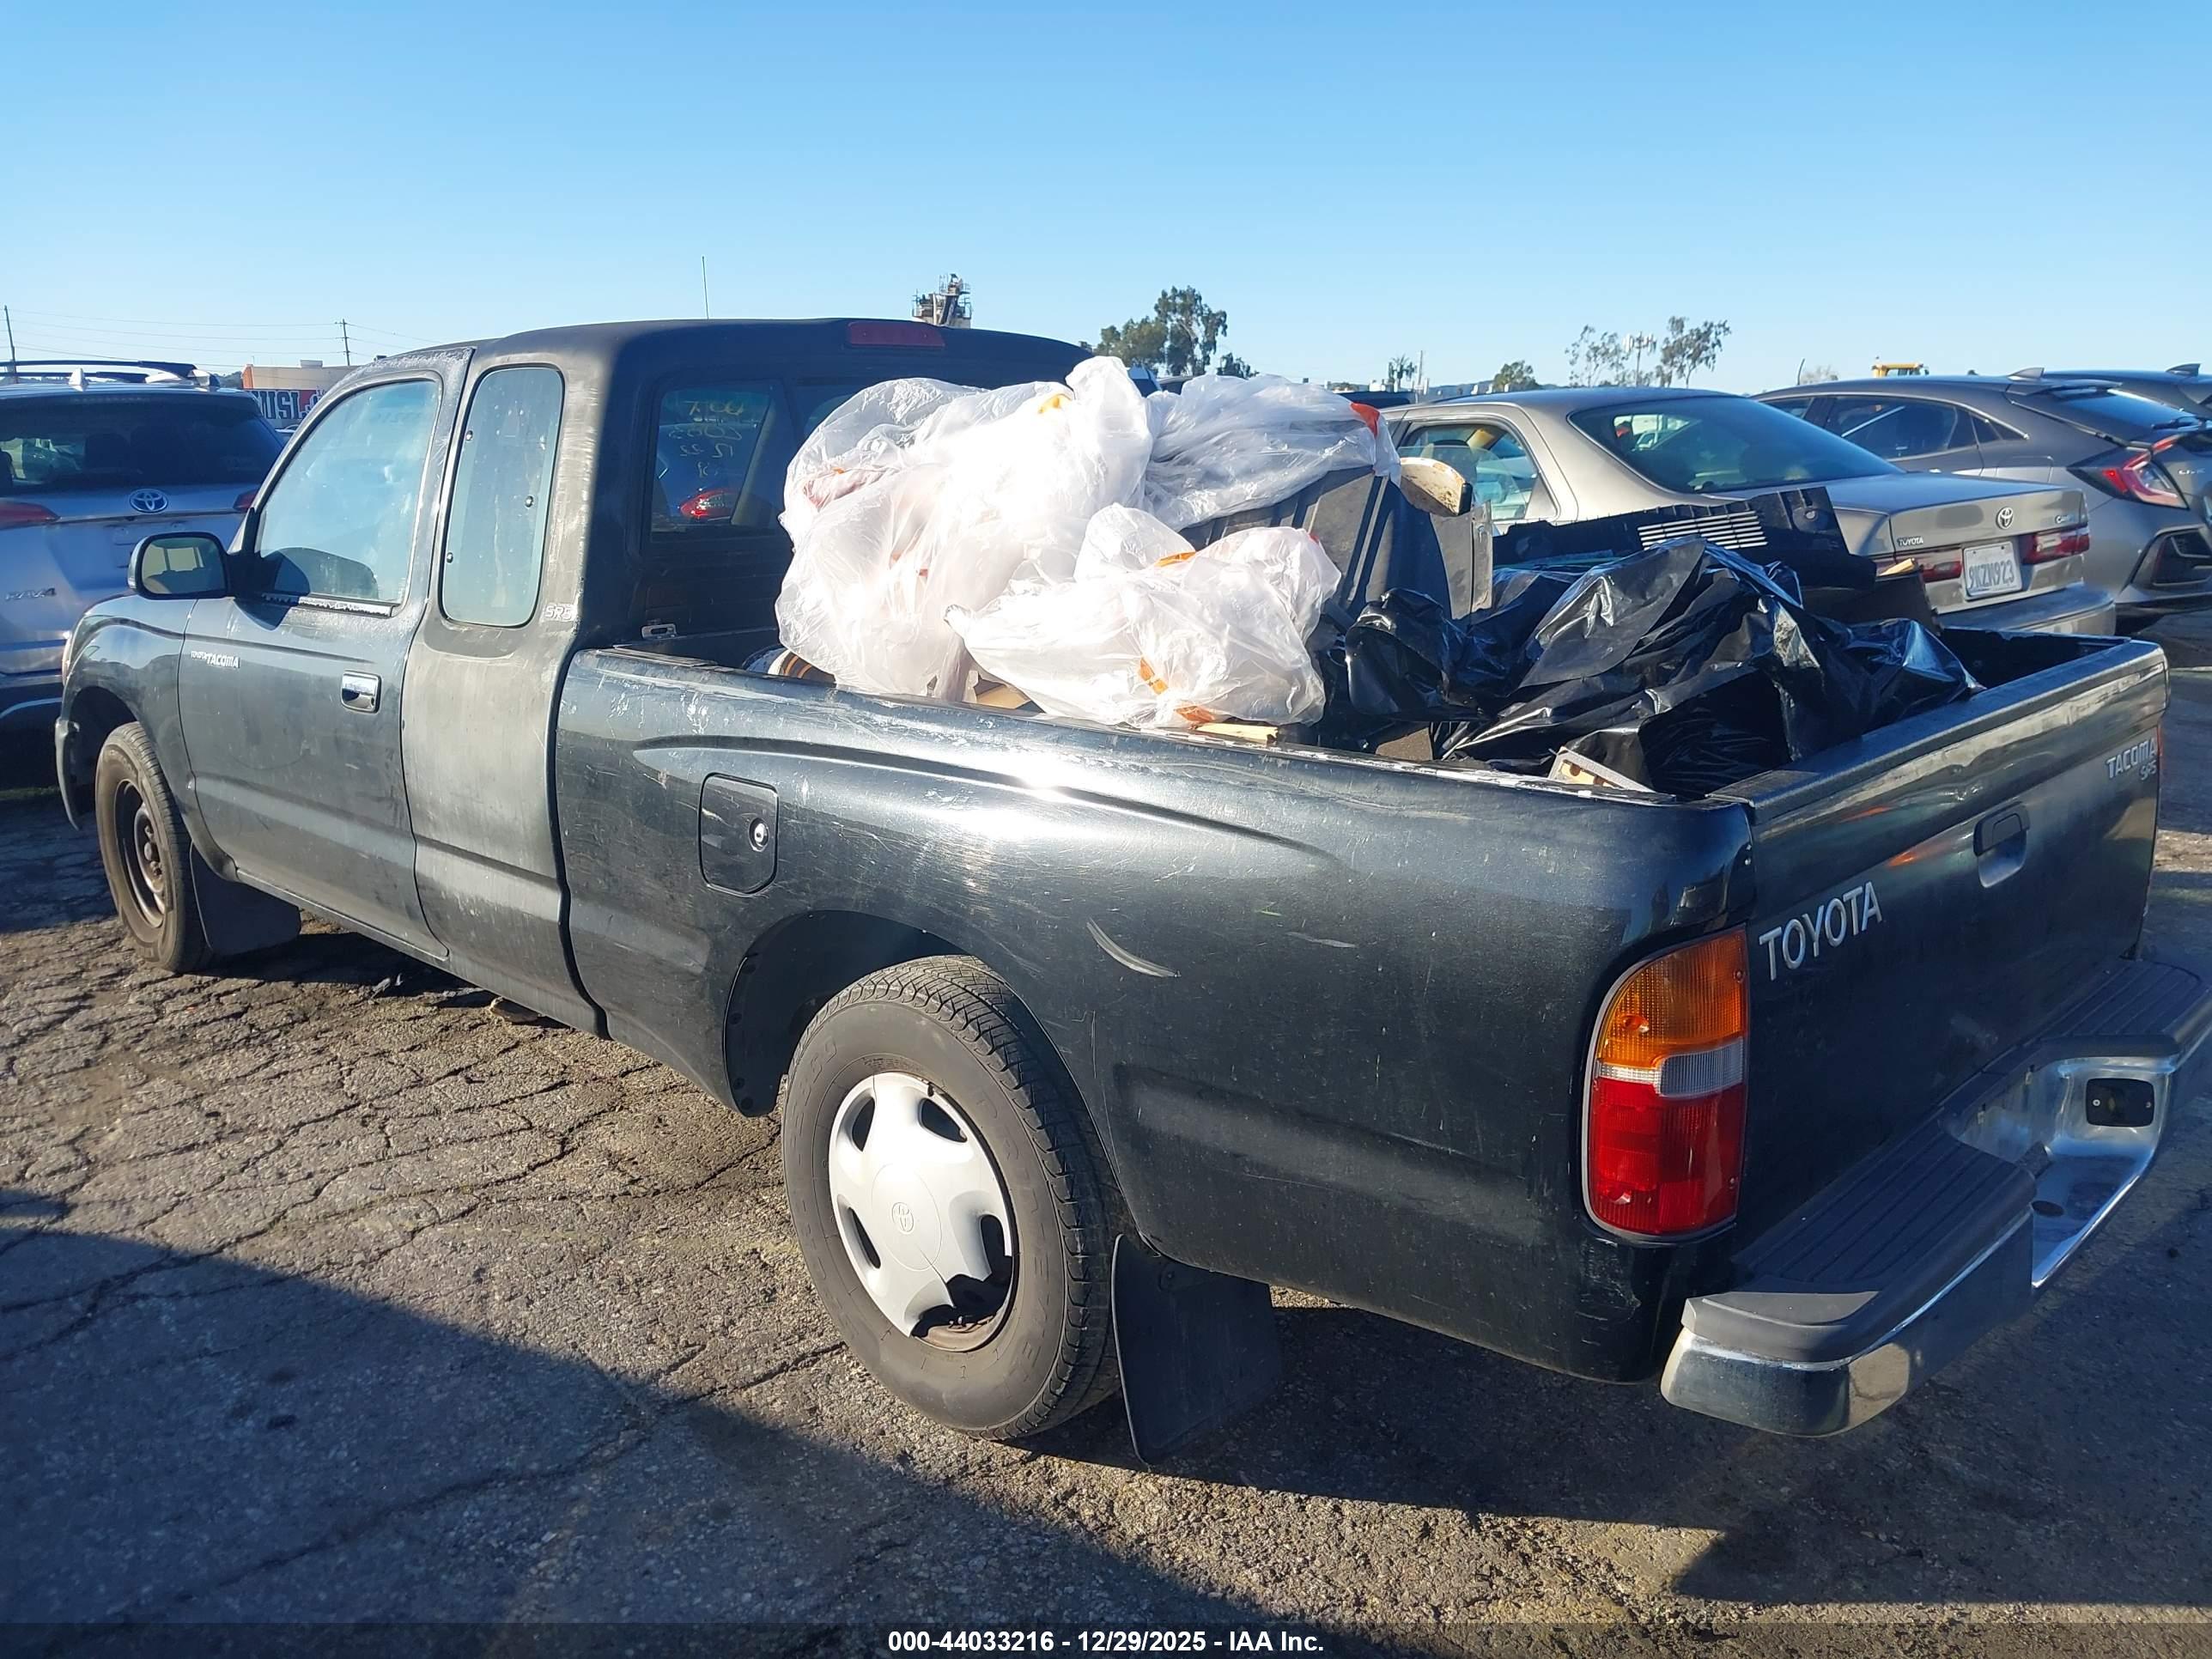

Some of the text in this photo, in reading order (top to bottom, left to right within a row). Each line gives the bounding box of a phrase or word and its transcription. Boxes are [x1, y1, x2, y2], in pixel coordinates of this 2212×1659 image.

[1896, 535, 1924, 547] TOYOTA
[206, 652, 240, 669] TACOMA
[2106, 737, 2158, 780] TACOMA
[1759, 880, 1883, 981] TOYOTA
